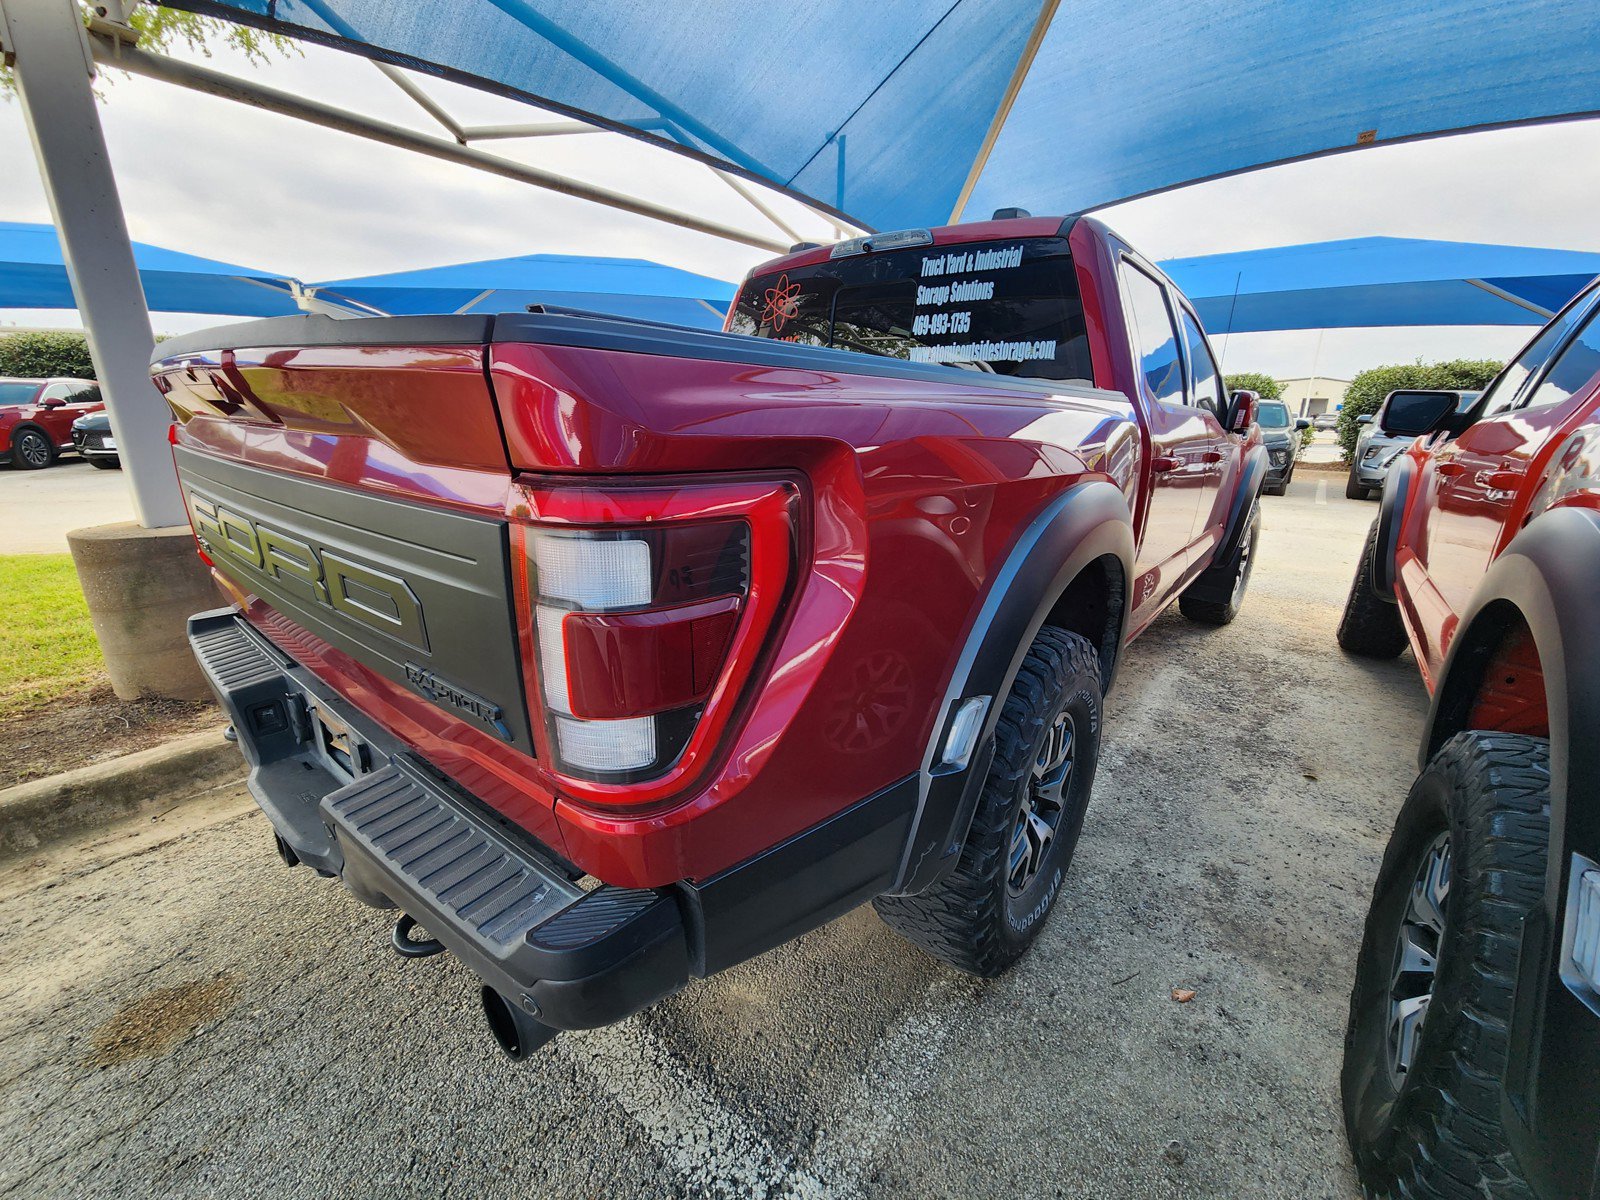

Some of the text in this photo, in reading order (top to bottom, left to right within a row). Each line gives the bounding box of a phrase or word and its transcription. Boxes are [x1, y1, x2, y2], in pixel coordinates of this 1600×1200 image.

[921, 245, 1024, 278] Truck Yard & Industrial
[916, 279, 995, 306] Storage Solutions
[912, 311, 972, 336] 469-893-1735
[909, 339, 1057, 363] www.atomicoutsidestorage.com
[190, 491, 432, 658] FORD
[404, 659, 515, 743] RAPTOR
